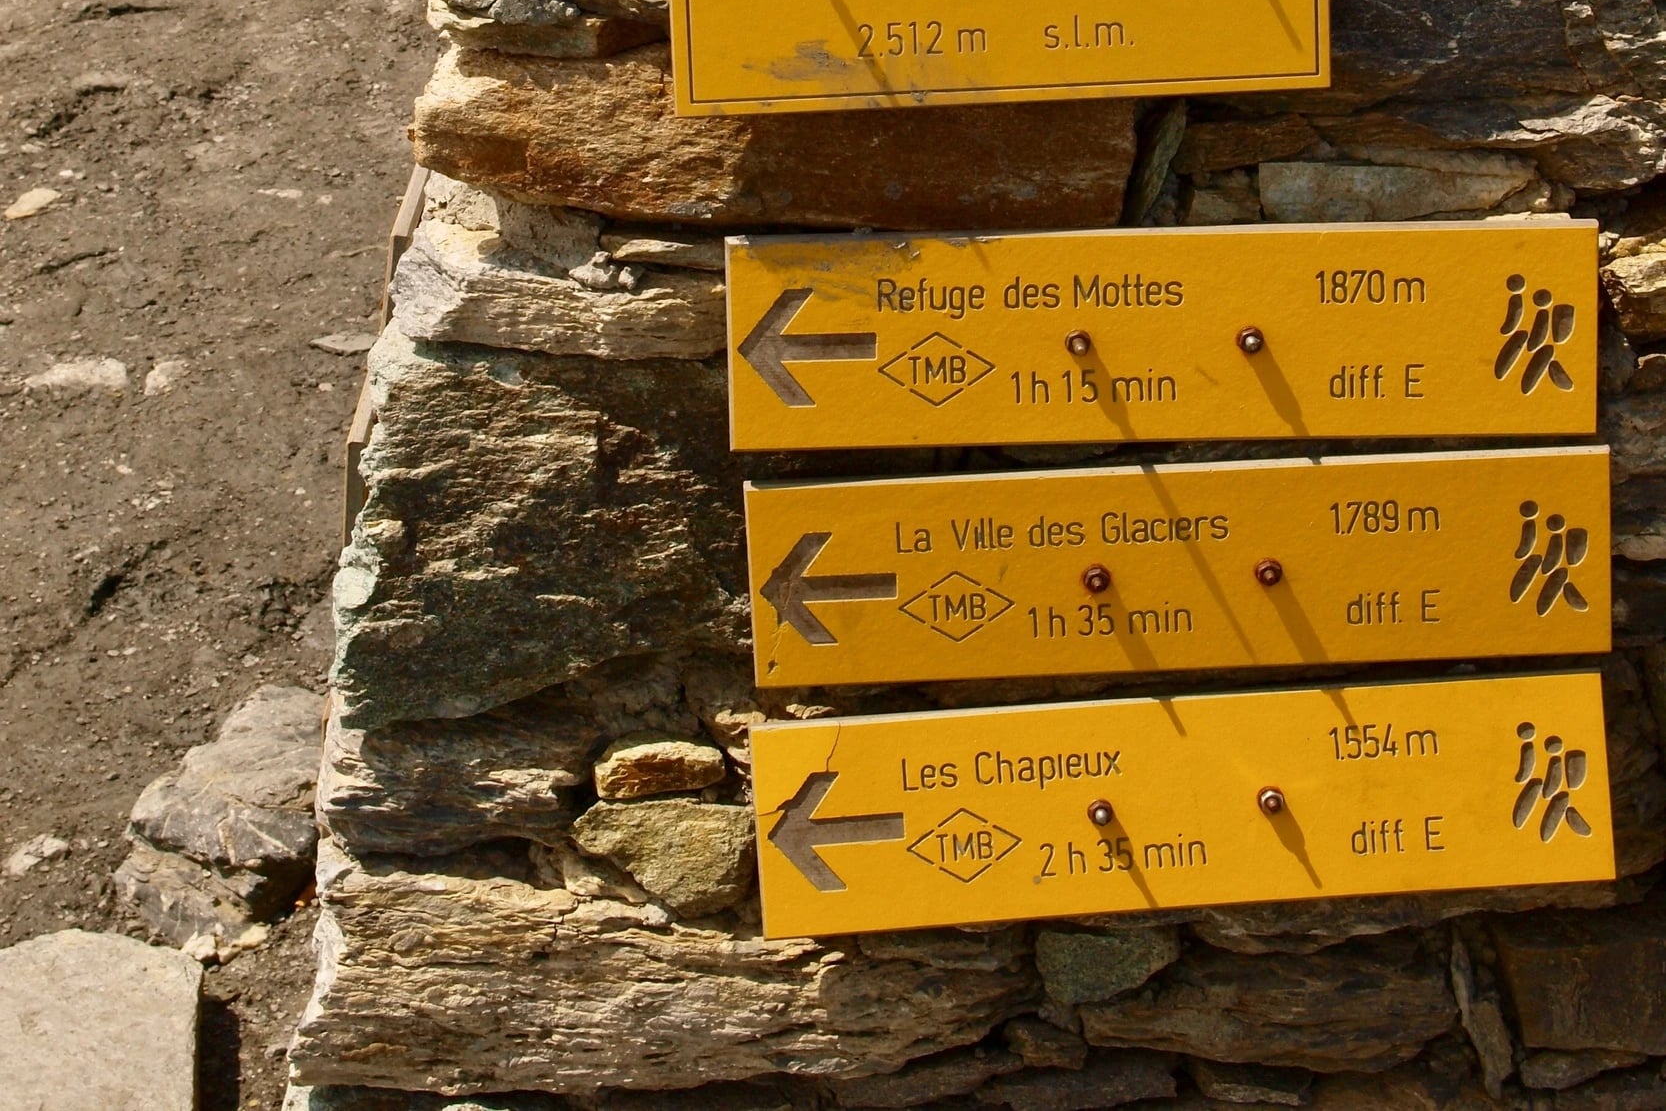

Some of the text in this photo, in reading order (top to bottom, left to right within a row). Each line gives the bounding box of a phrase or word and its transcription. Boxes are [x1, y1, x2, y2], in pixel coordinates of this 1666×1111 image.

[855, 19, 990, 60] 2.512 m
[1042, 12, 1137, 52] s.l.m.
[875, 272, 1186, 320] Refuge des Mottes
[1391, 274, 1427, 305] m
[906, 353, 969, 386] TMB
[1060, 368, 1100, 404] 15
[1110, 366, 1180, 403] min
[1328, 362, 1426, 400] diff. E
[893, 519, 935, 555] La
[1026, 513, 1087, 550] des
[1406, 504, 1441, 533] m
[926, 590, 989, 624] TMB
[1076, 602, 1116, 638] 35
[1126, 599, 1195, 635] min
[1345, 587, 1442, 628] diff. E
[1404, 727, 1440, 757] m
[900, 755, 960, 793] Les
[935, 828, 996, 864] TMB
[1094, 836, 1136, 873] 35
[1142, 832, 1209, 870] min
[1350, 814, 1446, 857] diff. E
